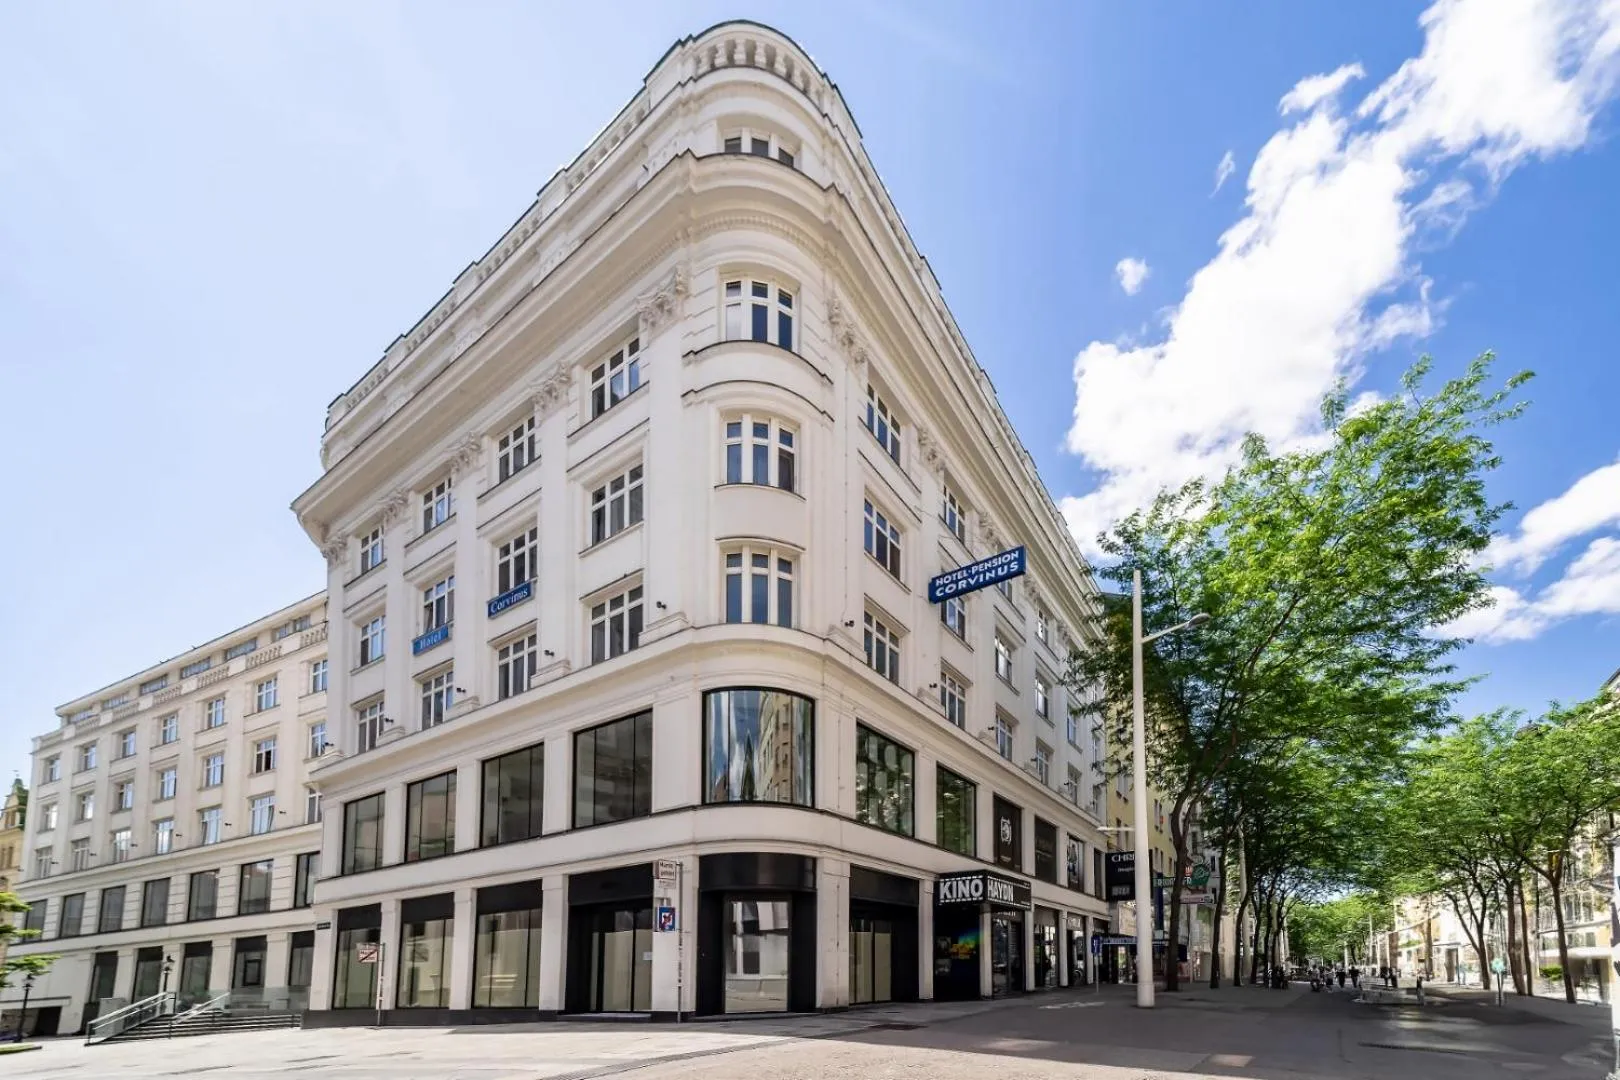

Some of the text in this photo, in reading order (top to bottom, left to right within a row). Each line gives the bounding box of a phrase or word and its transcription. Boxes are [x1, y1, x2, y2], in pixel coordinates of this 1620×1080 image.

[935, 561, 1019, 597] CORVINUS
[490, 588, 528, 613] Corvinus
[940, 878, 1014, 902] KINO HAYDN
